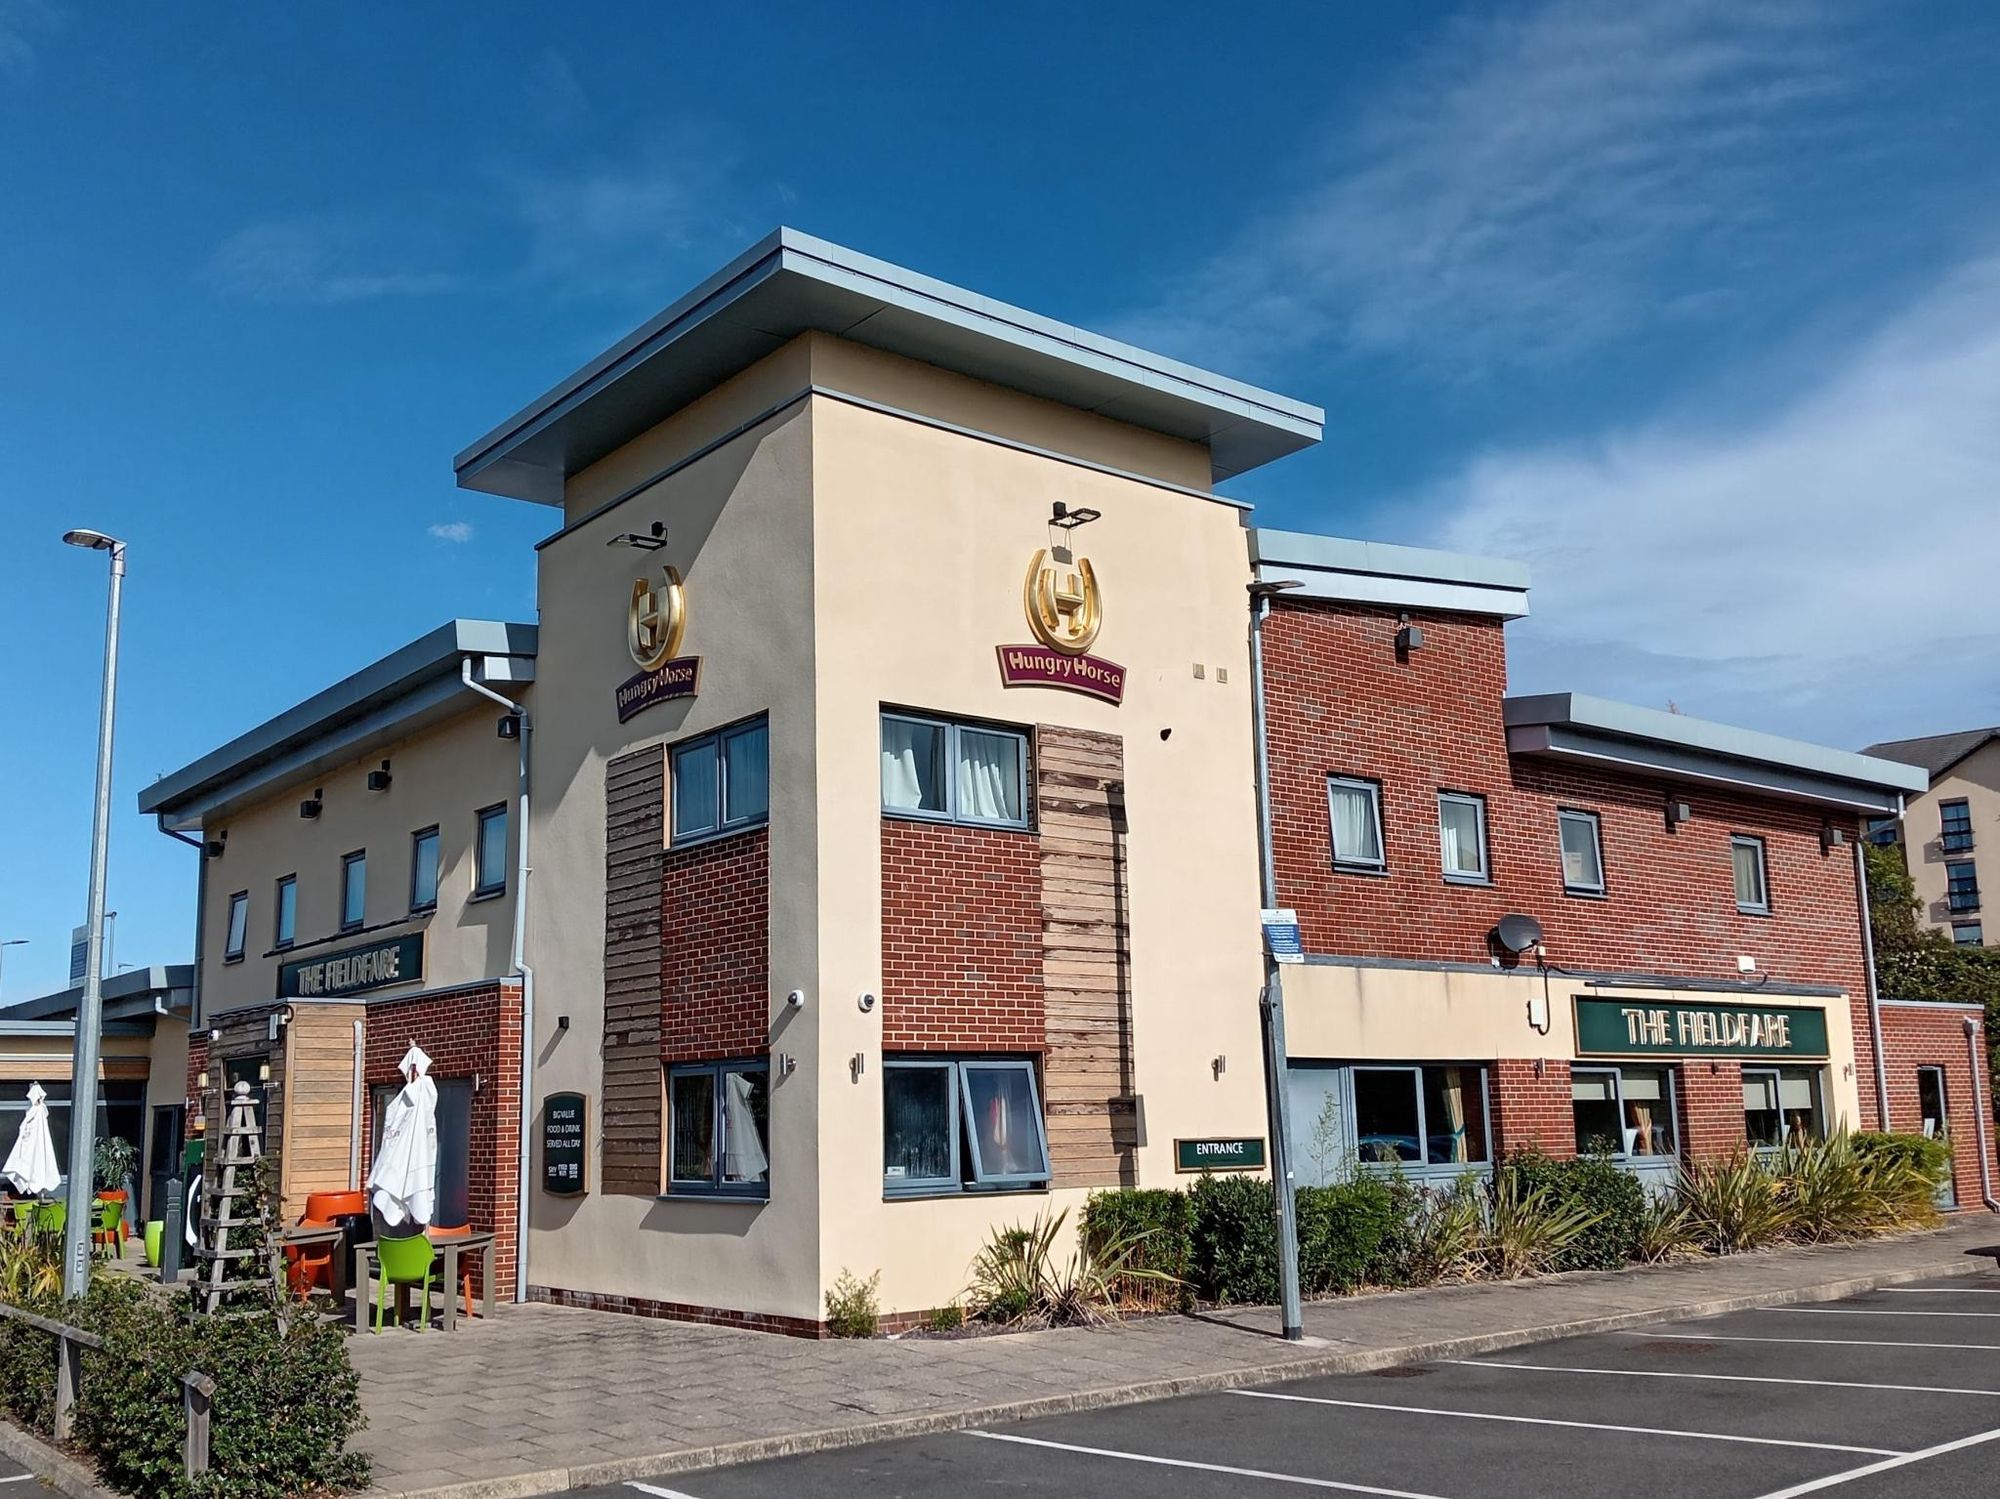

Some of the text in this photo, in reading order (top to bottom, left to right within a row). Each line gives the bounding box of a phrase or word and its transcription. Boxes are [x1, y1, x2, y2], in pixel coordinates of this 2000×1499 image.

[297, 945, 400, 996] THE FIELDFARE
[1621, 1008, 1793, 1049] THE FIELDFARE
[547, 1125, 561, 1134] FOOD
[1196, 1142, 1244, 1155] ENTRANCE
